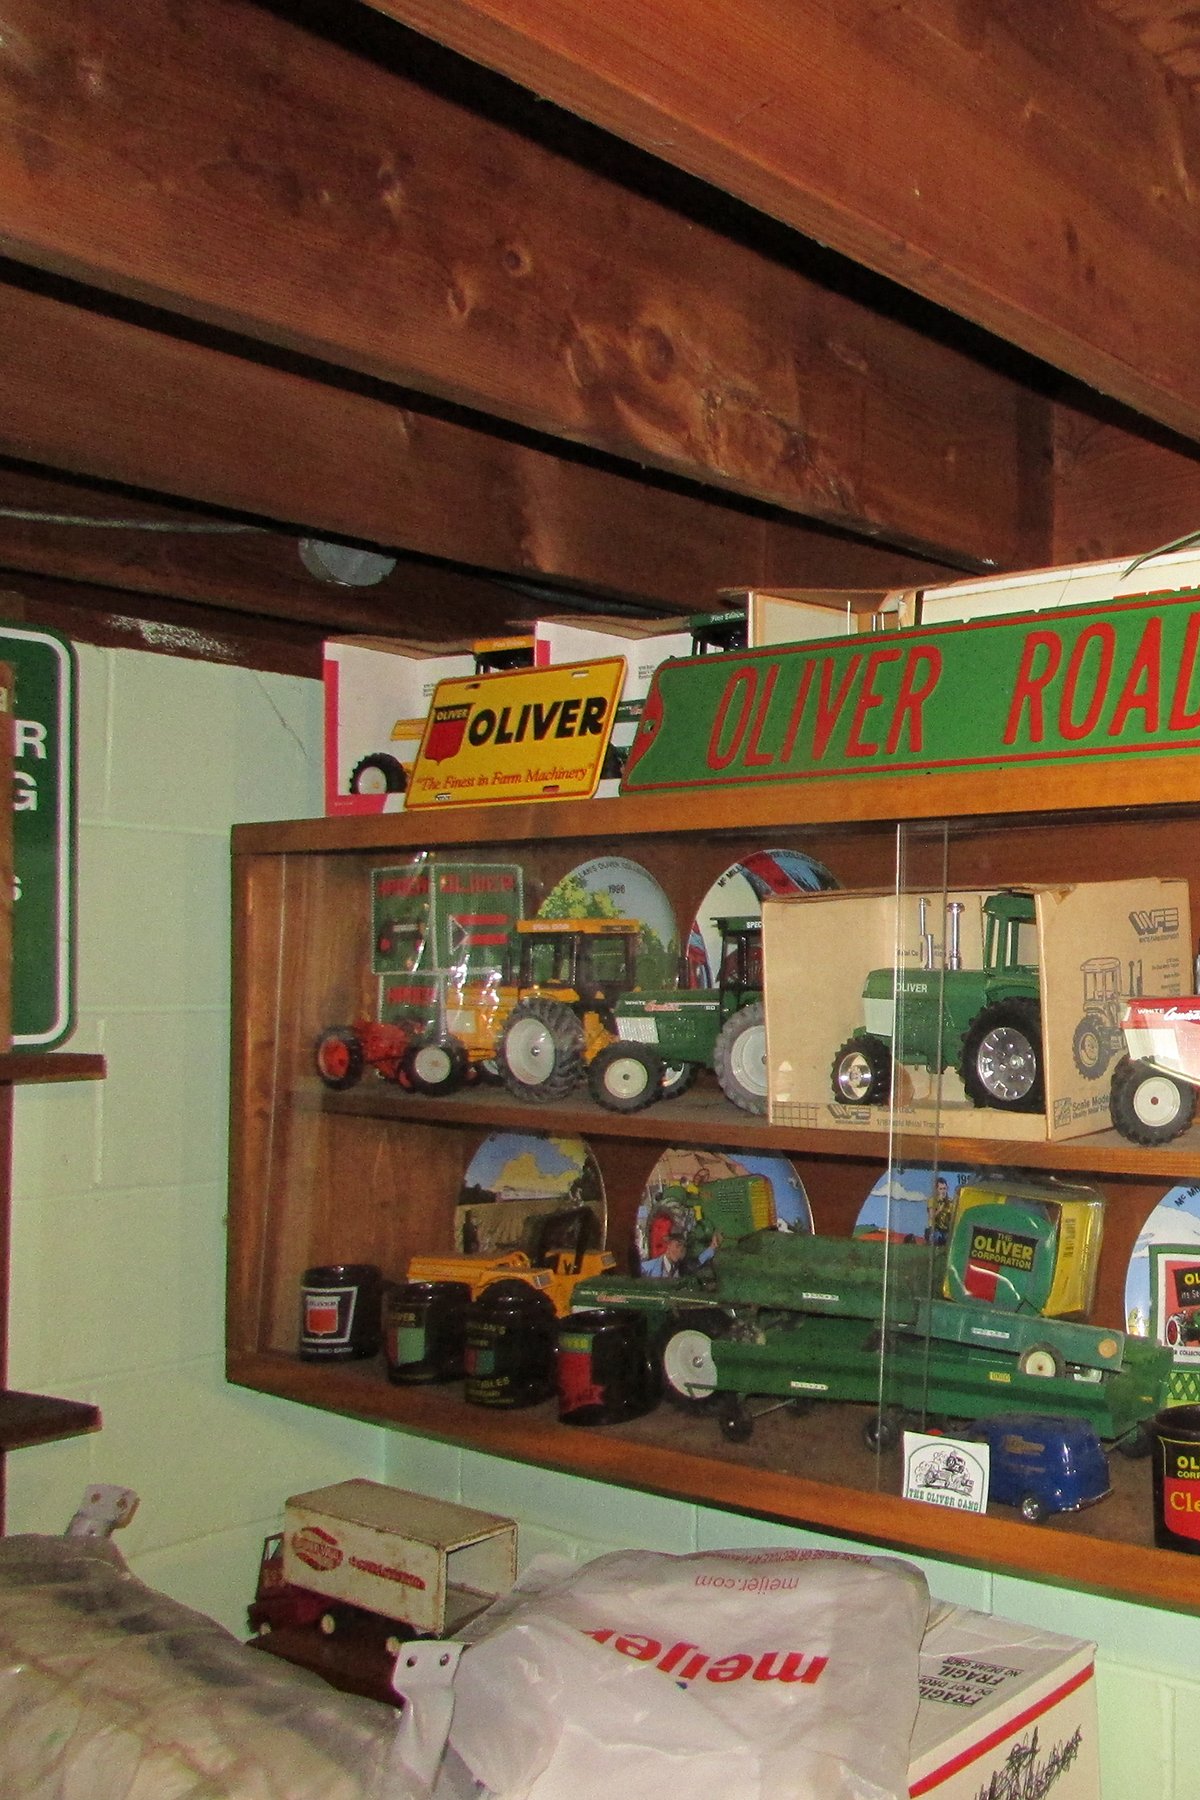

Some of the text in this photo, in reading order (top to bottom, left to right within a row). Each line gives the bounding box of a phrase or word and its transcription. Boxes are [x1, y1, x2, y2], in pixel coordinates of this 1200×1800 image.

[436, 708, 469, 721] OLIVER
[705, 643, 943, 772] OLIVER
[468, 697, 609, 747] OLIVER
[443, 776, 475, 789] Finest
[478, 774, 489, 786] in
[492, 771, 522, 785] Farm
[746, 921, 763, 929] SPEC
[895, 982, 928, 993] OLIVER
[998, 1233, 1013, 1242] THE
[973, 1235, 1034, 1261] OLIVER
[971, 1250, 1033, 1269] CORPORATION
[908, 1488, 925, 1500] THE
[926, 1491, 956, 1507] OLIVER
[694, 1574, 800, 1595] meijer.com
[937, 1665, 1006, 1686] FRAGIL
[1004, 1669, 1022, 1678] NO
[948, 1684, 974, 1693] NOT
[974, 1688, 994, 1696] DO
